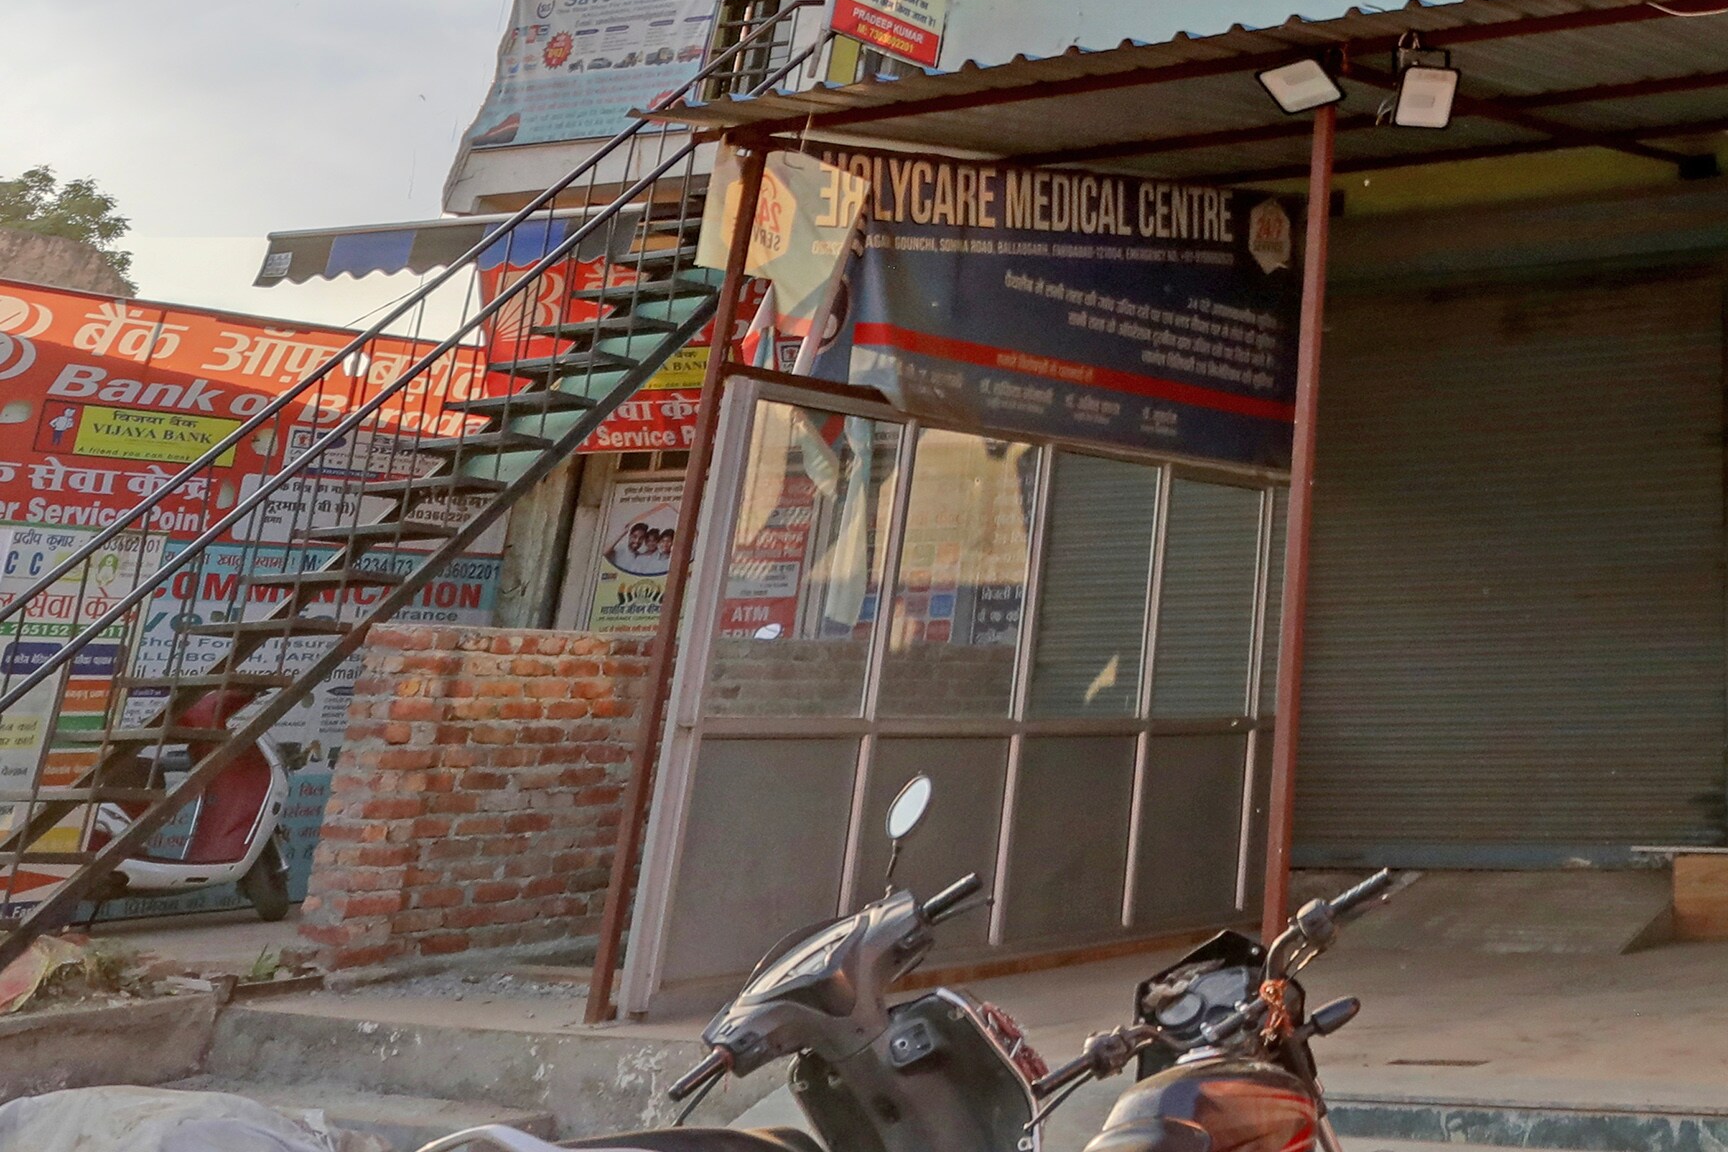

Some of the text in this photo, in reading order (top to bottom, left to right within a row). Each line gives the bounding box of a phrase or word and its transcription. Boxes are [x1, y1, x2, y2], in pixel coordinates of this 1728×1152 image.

[853, 7, 924, 44] PRADEEP KUMAR
[823, 151, 1234, 242] LYCARE MEDICAL CENTRE
[73, 300, 189, 362] बैंक
[47, 363, 224, 413] Bank
[92, 422, 213, 445] VIJAYA BANK
[597, 425, 676, 448] Service
[28, 456, 121, 495] सेवा
[142, 505, 210, 532] Point
[12, 529, 75, 551] प्रदीप कुमार
[731, 606, 769, 622] ATM
